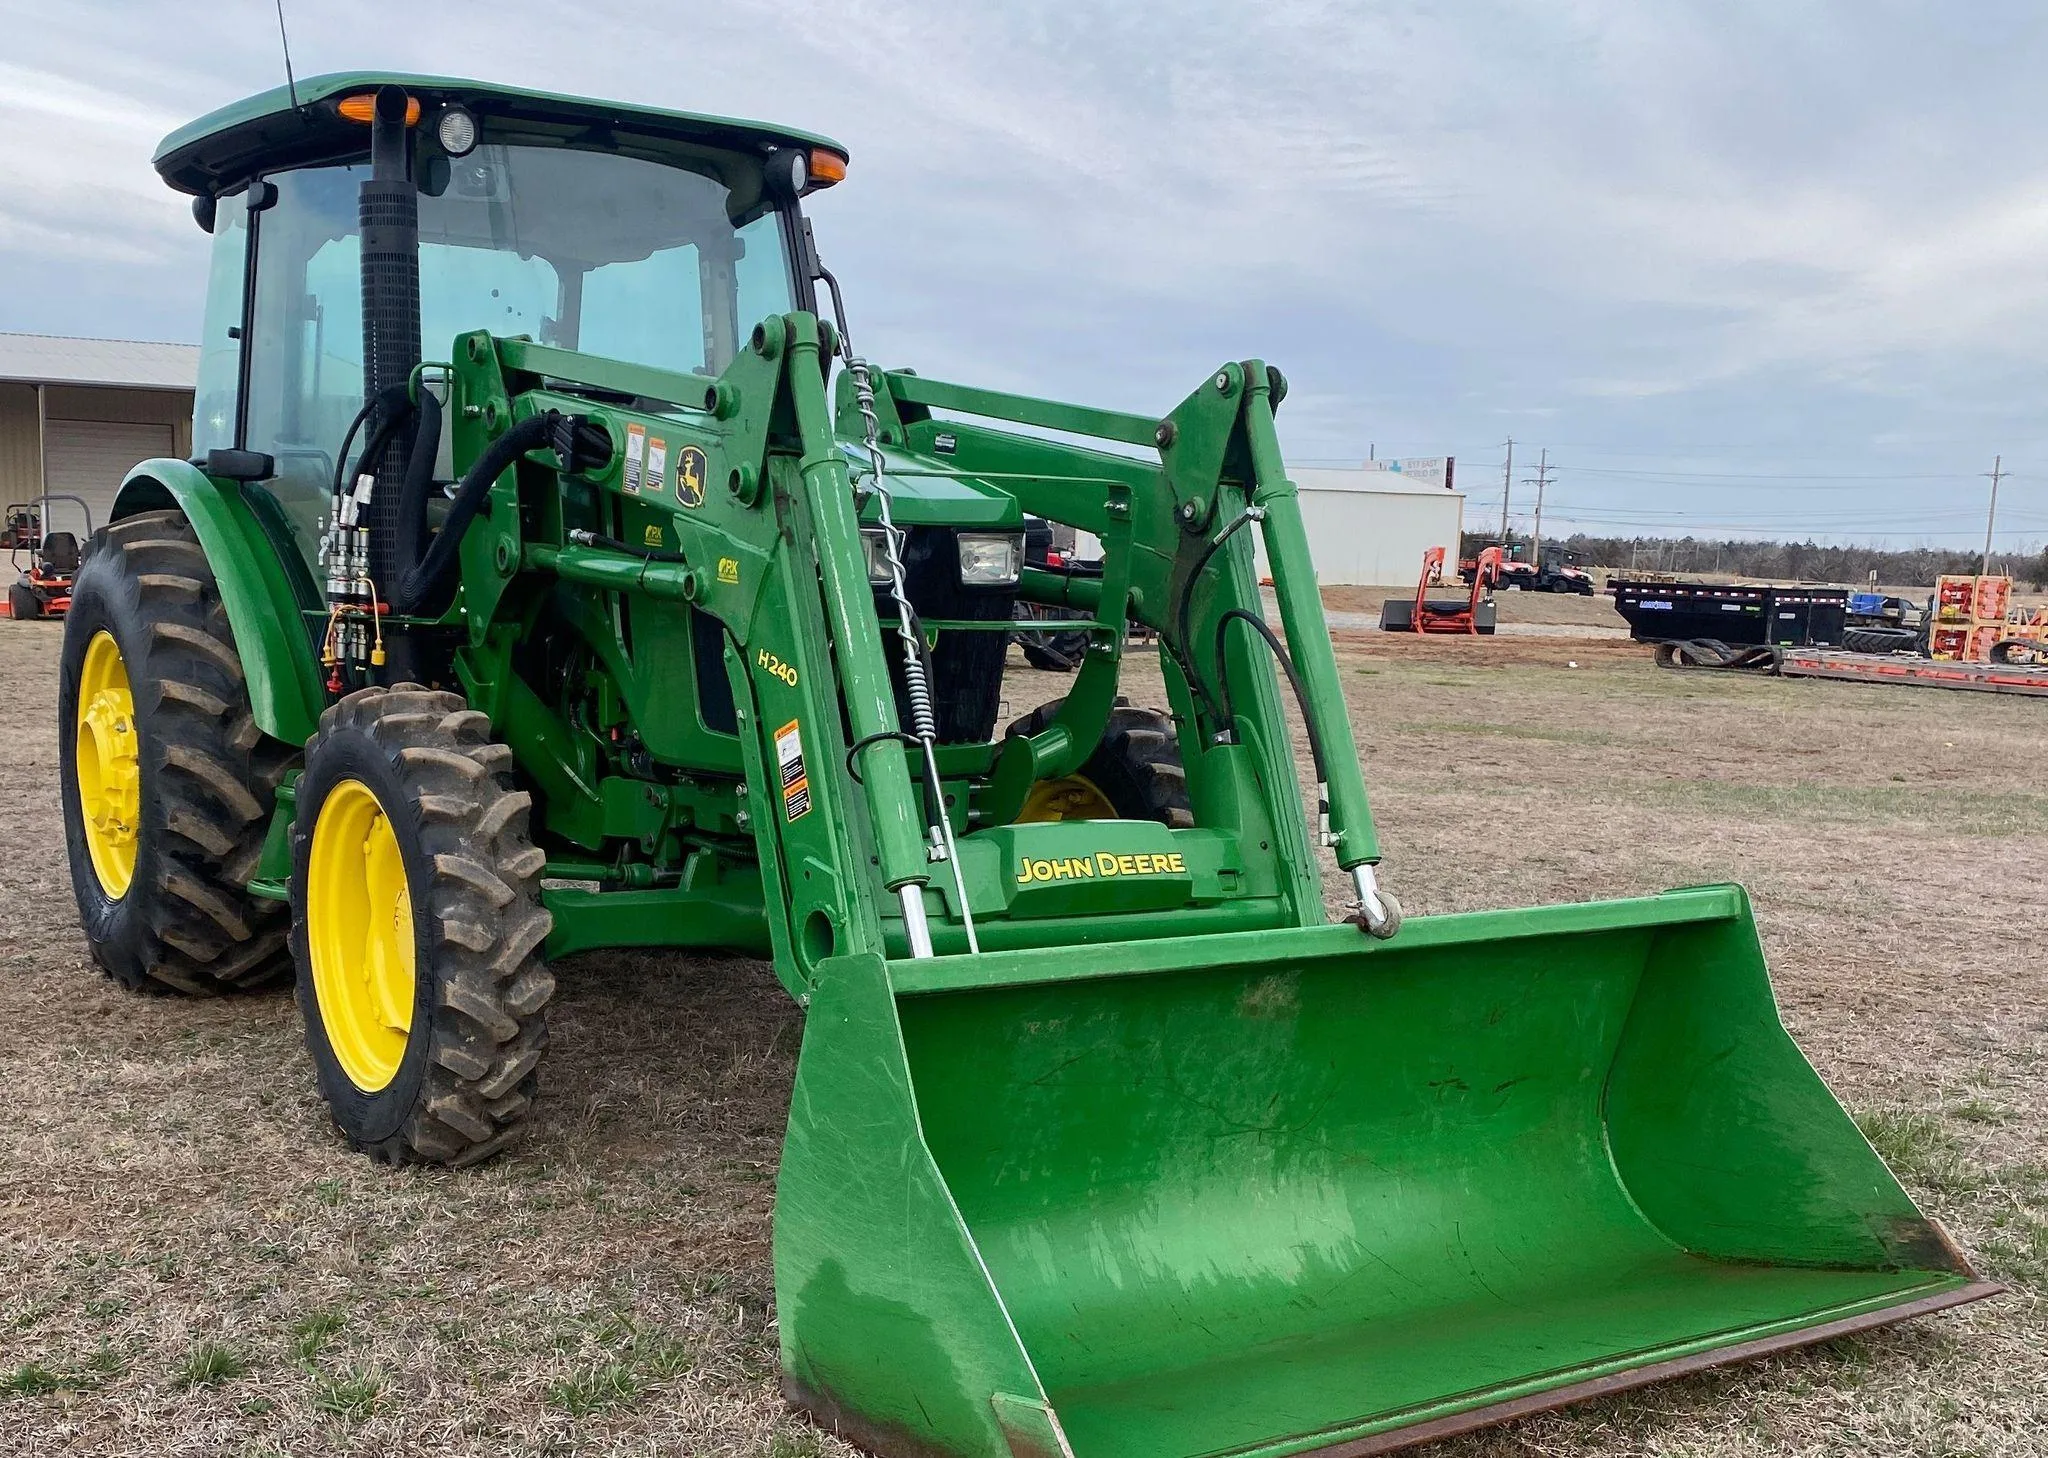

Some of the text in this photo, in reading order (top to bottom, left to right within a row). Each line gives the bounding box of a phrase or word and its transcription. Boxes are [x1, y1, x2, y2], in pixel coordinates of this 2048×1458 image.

[759, 649, 798, 687] H240
[1017, 851, 1187, 884] JOHN DEERE
